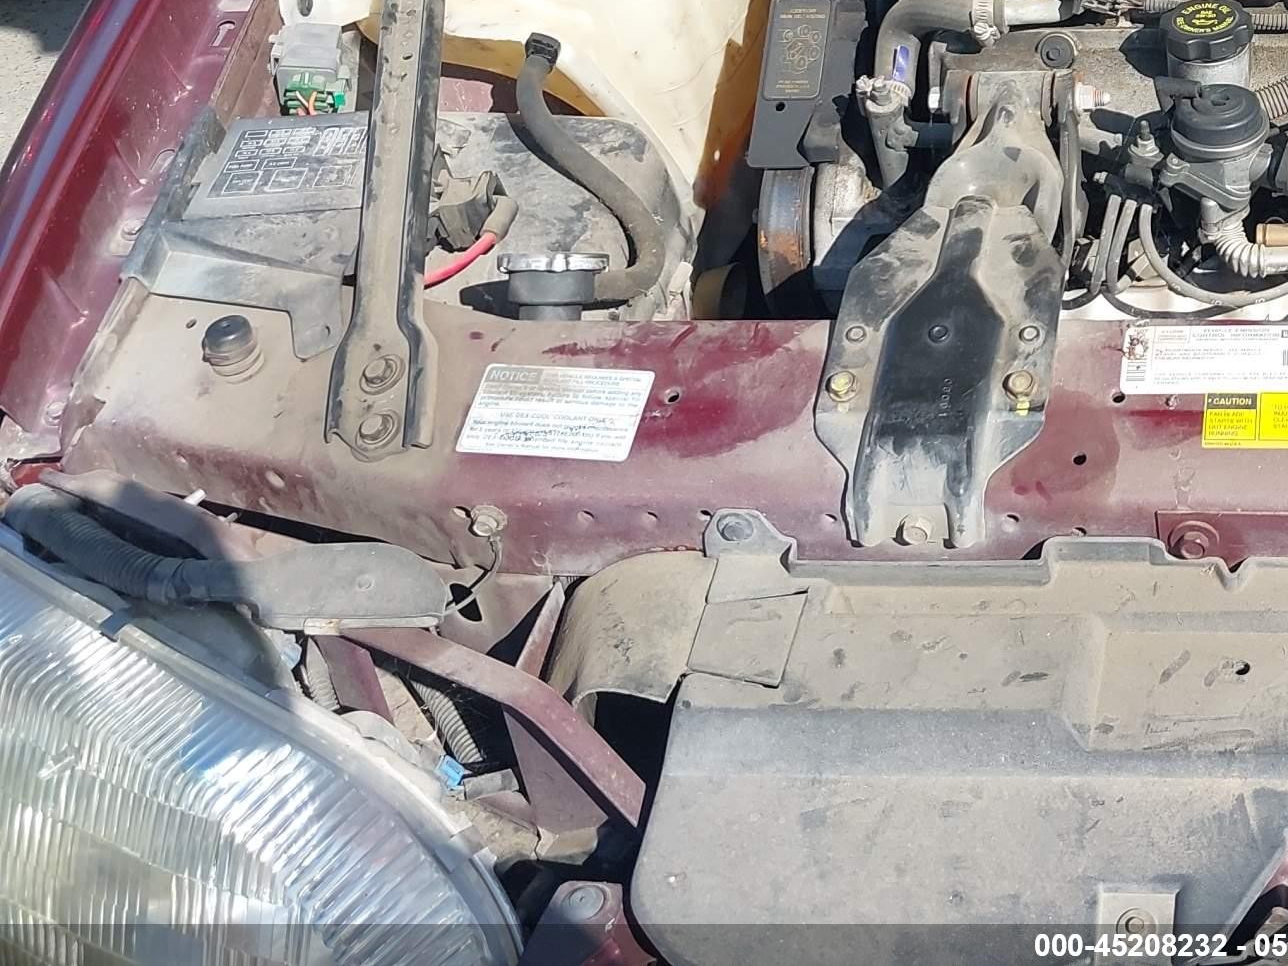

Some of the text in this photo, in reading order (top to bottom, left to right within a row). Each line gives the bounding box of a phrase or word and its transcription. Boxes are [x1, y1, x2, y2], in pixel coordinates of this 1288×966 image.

[1180, 2, 1220, 15] ENGINE
[489, 369, 538, 382] NOTICE
[1212, 397, 1252, 405] CAUTION
